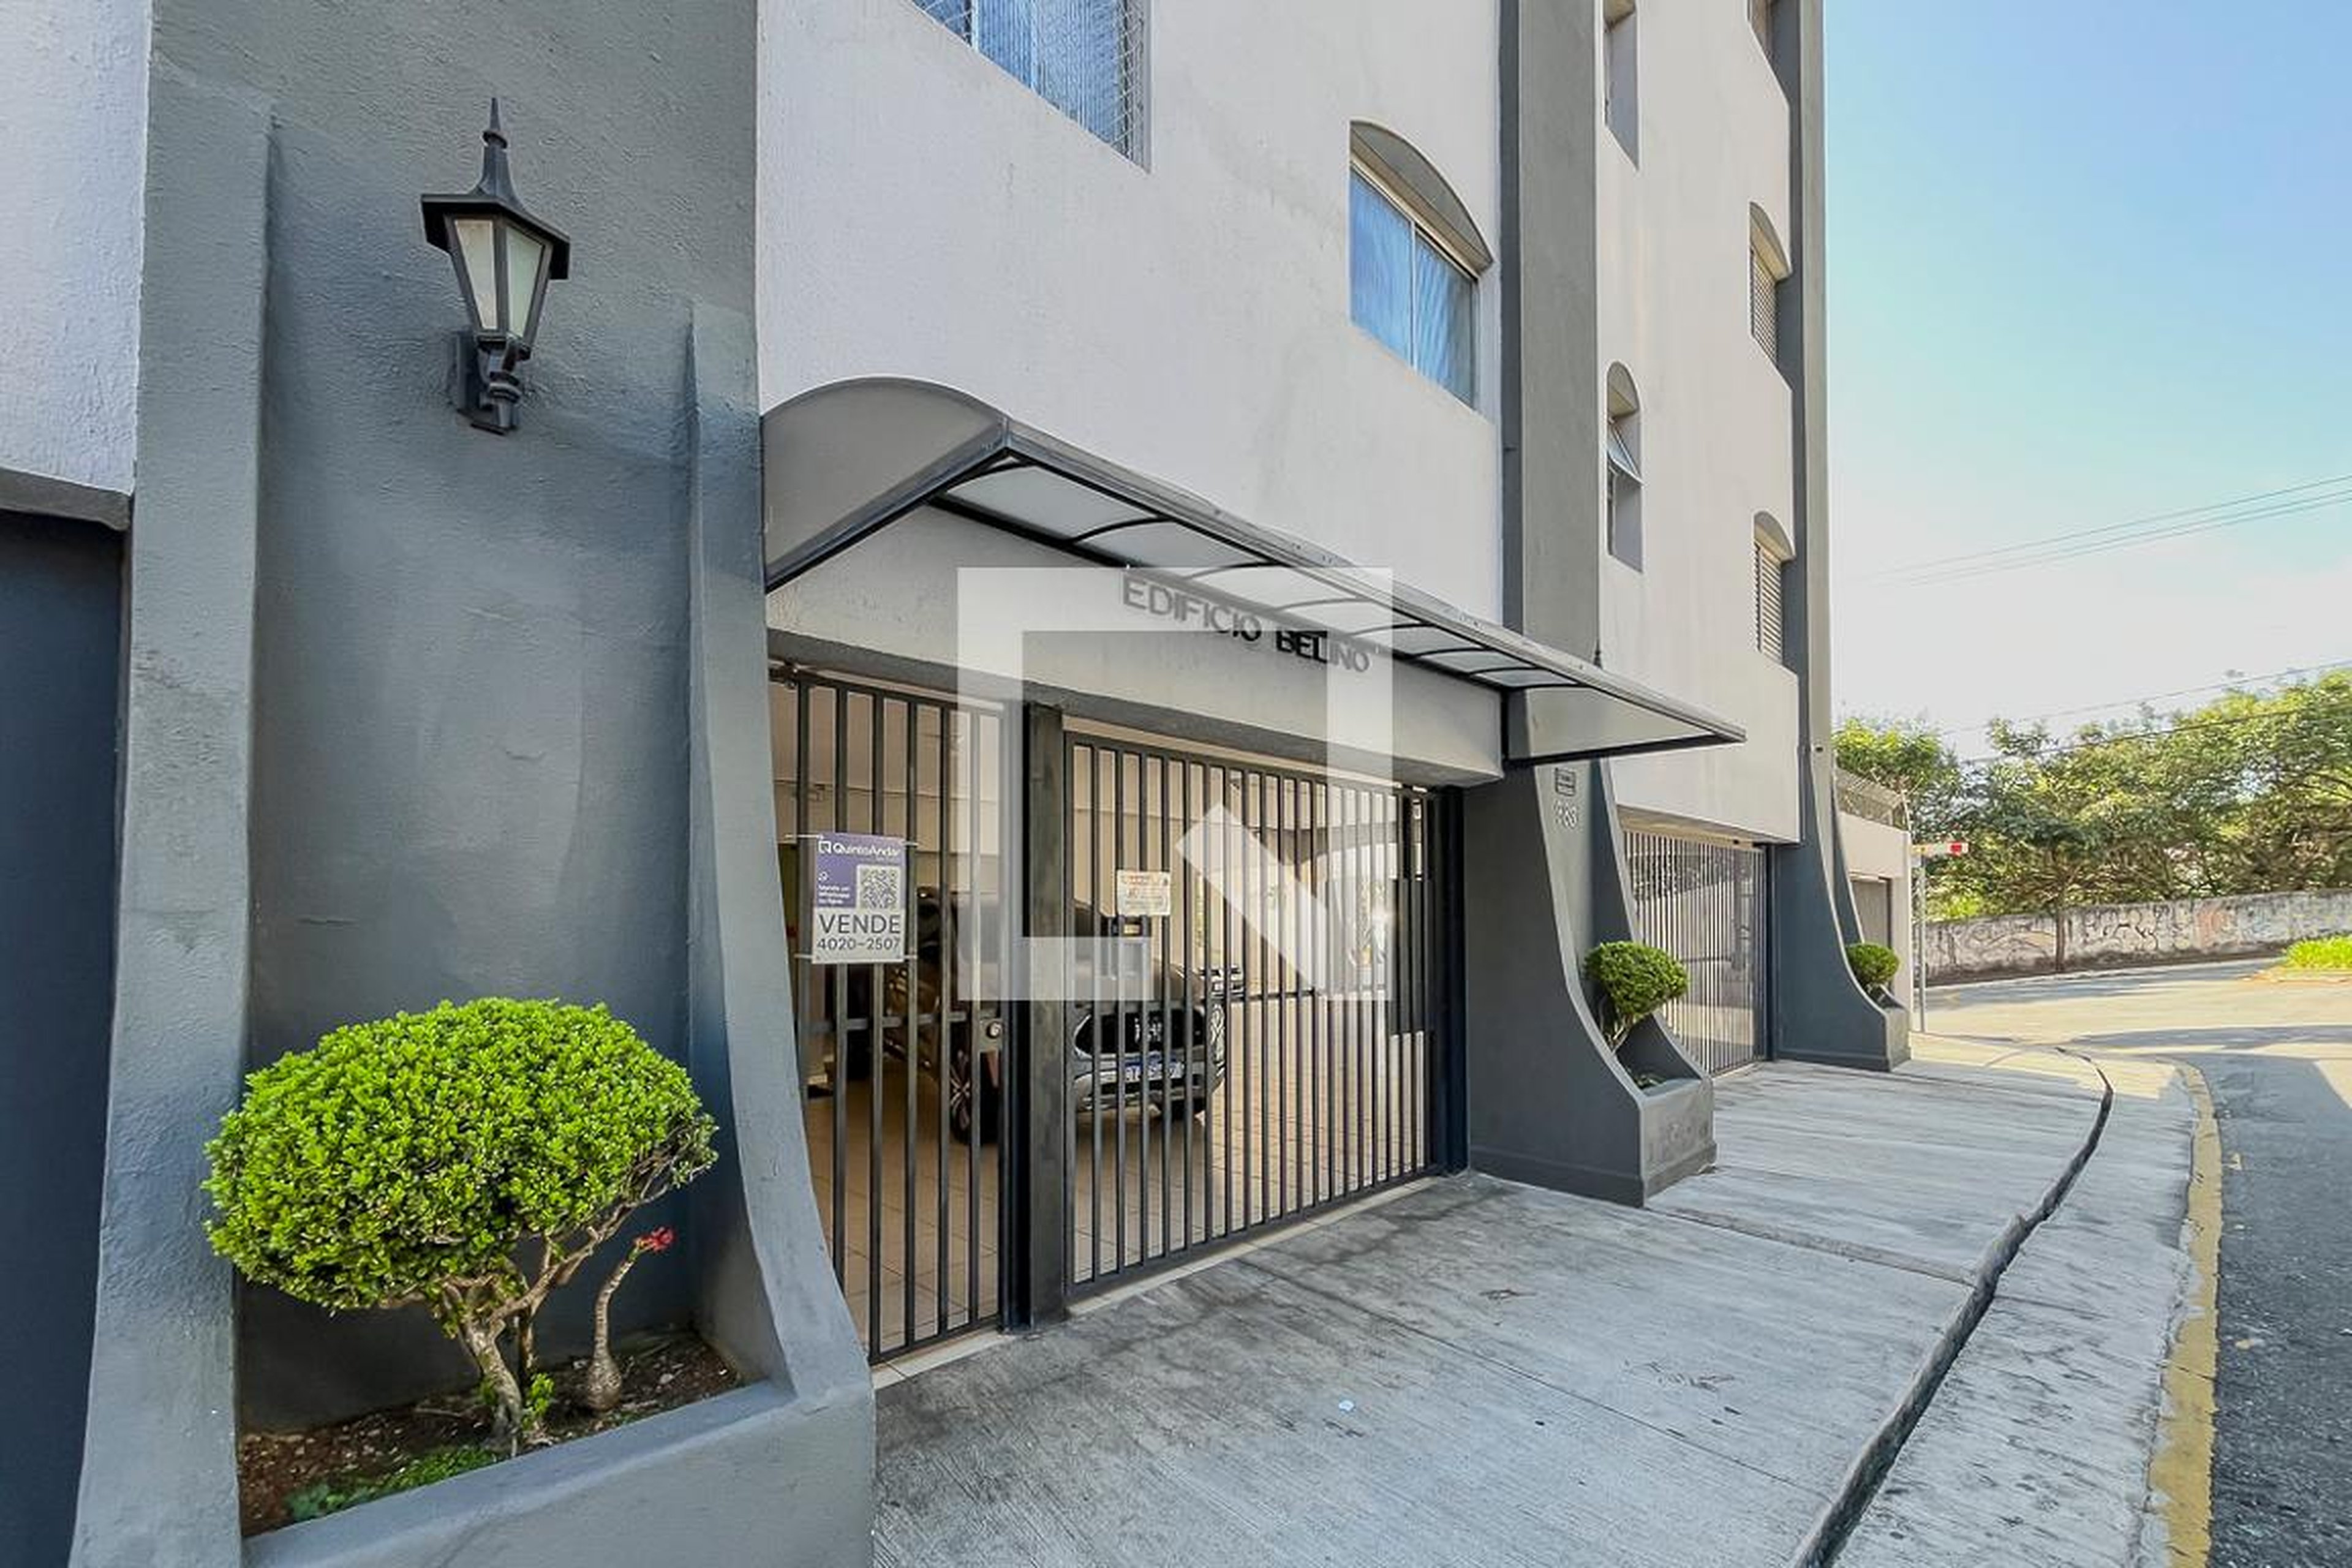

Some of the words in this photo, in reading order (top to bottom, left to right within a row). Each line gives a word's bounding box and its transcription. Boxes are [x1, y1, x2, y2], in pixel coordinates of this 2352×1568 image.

[833, 842, 901, 856] QuintoAndar
[819, 914, 901, 934] VENDE
[817, 937, 901, 950] 4020-2507
